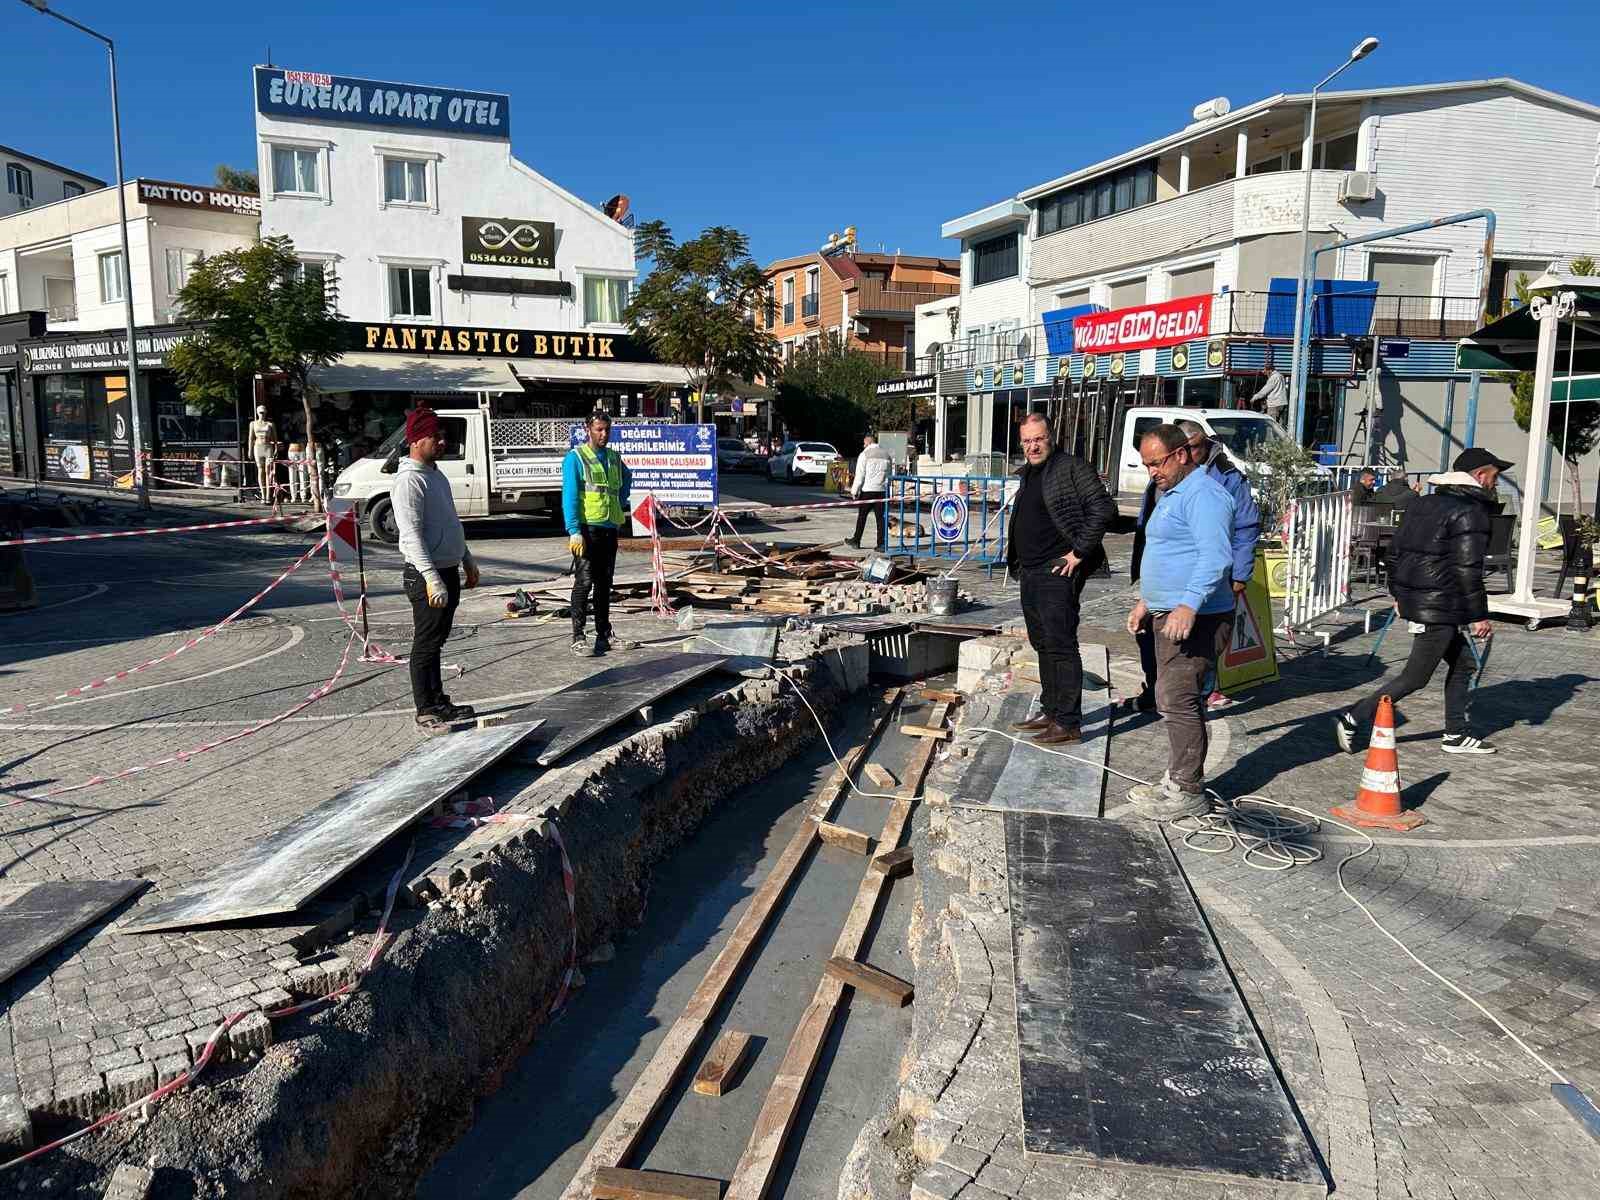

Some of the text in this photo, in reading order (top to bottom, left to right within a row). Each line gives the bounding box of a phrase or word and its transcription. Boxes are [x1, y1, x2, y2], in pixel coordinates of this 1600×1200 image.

[269, 78, 501, 126] EUREKA APART OTEL
[141, 183, 262, 210] TATTOO HOUSE
[470, 253, 497, 262] 0534
[498, 255, 520, 264] 422
[521, 256, 534, 265] 04
[365, 326, 615, 358] FANTASTIC BUTİK
[1074, 320, 1119, 348] MÜJDE!
[113, 341, 120, 355] &
[620, 427, 662, 439] DEĞERLİ
